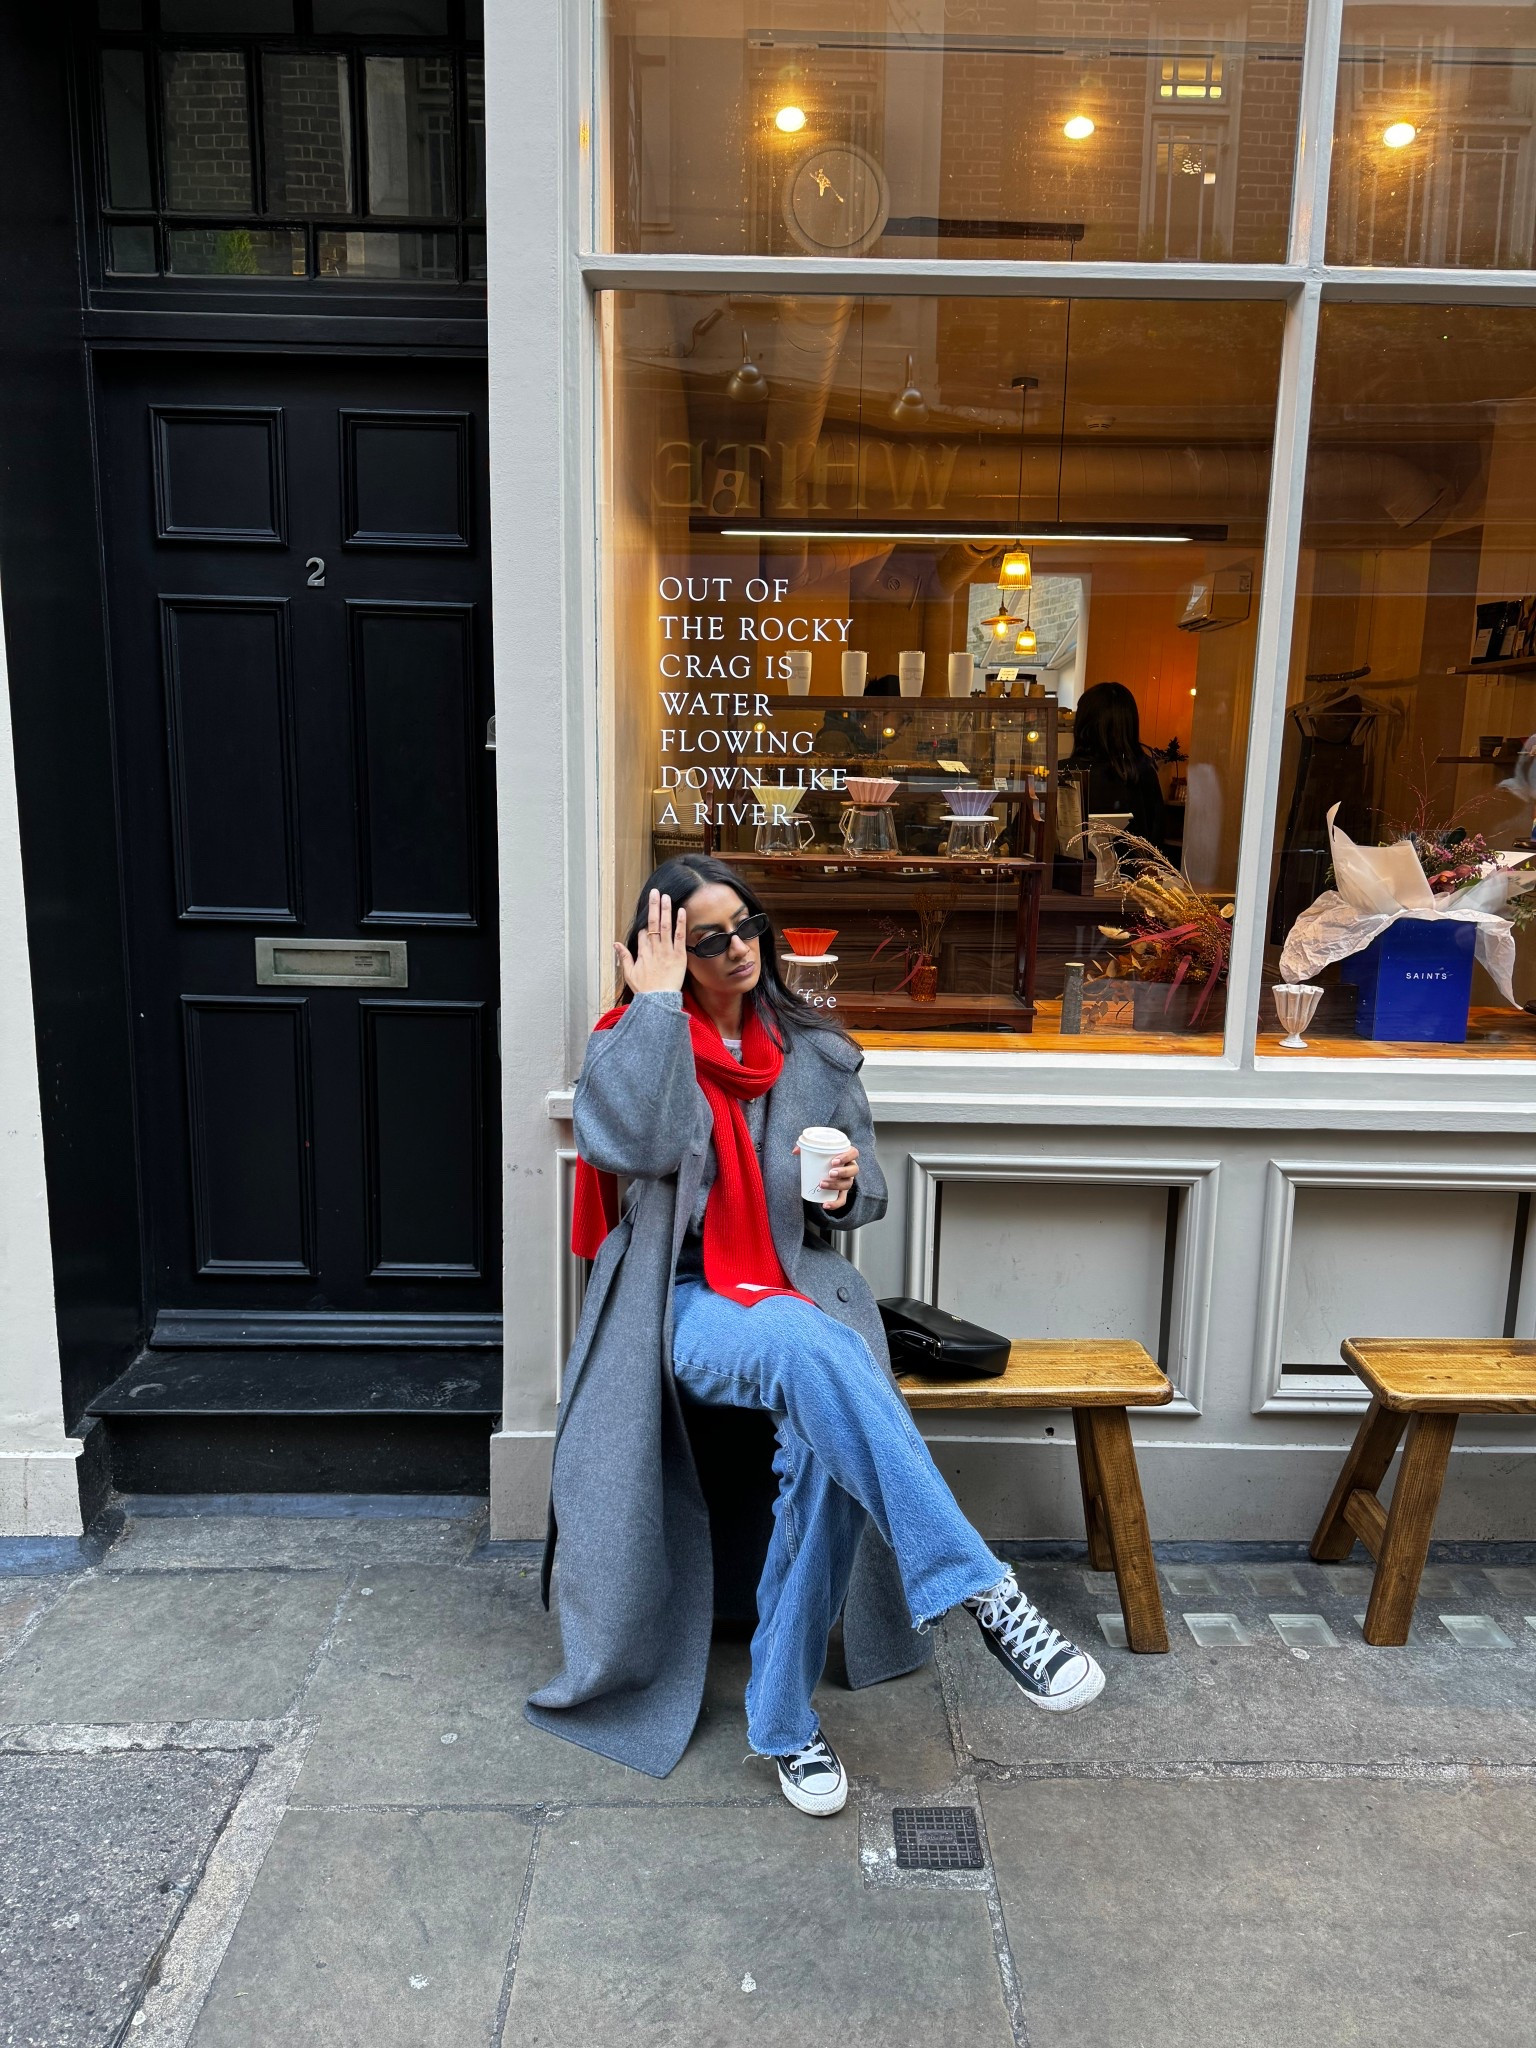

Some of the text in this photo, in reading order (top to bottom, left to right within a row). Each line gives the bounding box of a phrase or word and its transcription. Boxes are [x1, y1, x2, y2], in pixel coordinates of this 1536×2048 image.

[305, 556, 326, 587] 2
[659, 577, 789, 603] OUT OF
[658, 616, 854, 642] THE ROCKY
[659, 654, 751, 679] CRAG
[765, 656, 793, 680] IS
[659, 692, 773, 717] WATER
[661, 729, 814, 754] FLOWING
[661, 766, 848, 791] DOWN LIKE
[659, 802, 800, 826] A RIVER.
[1405, 972, 1448, 980] SAINTS
